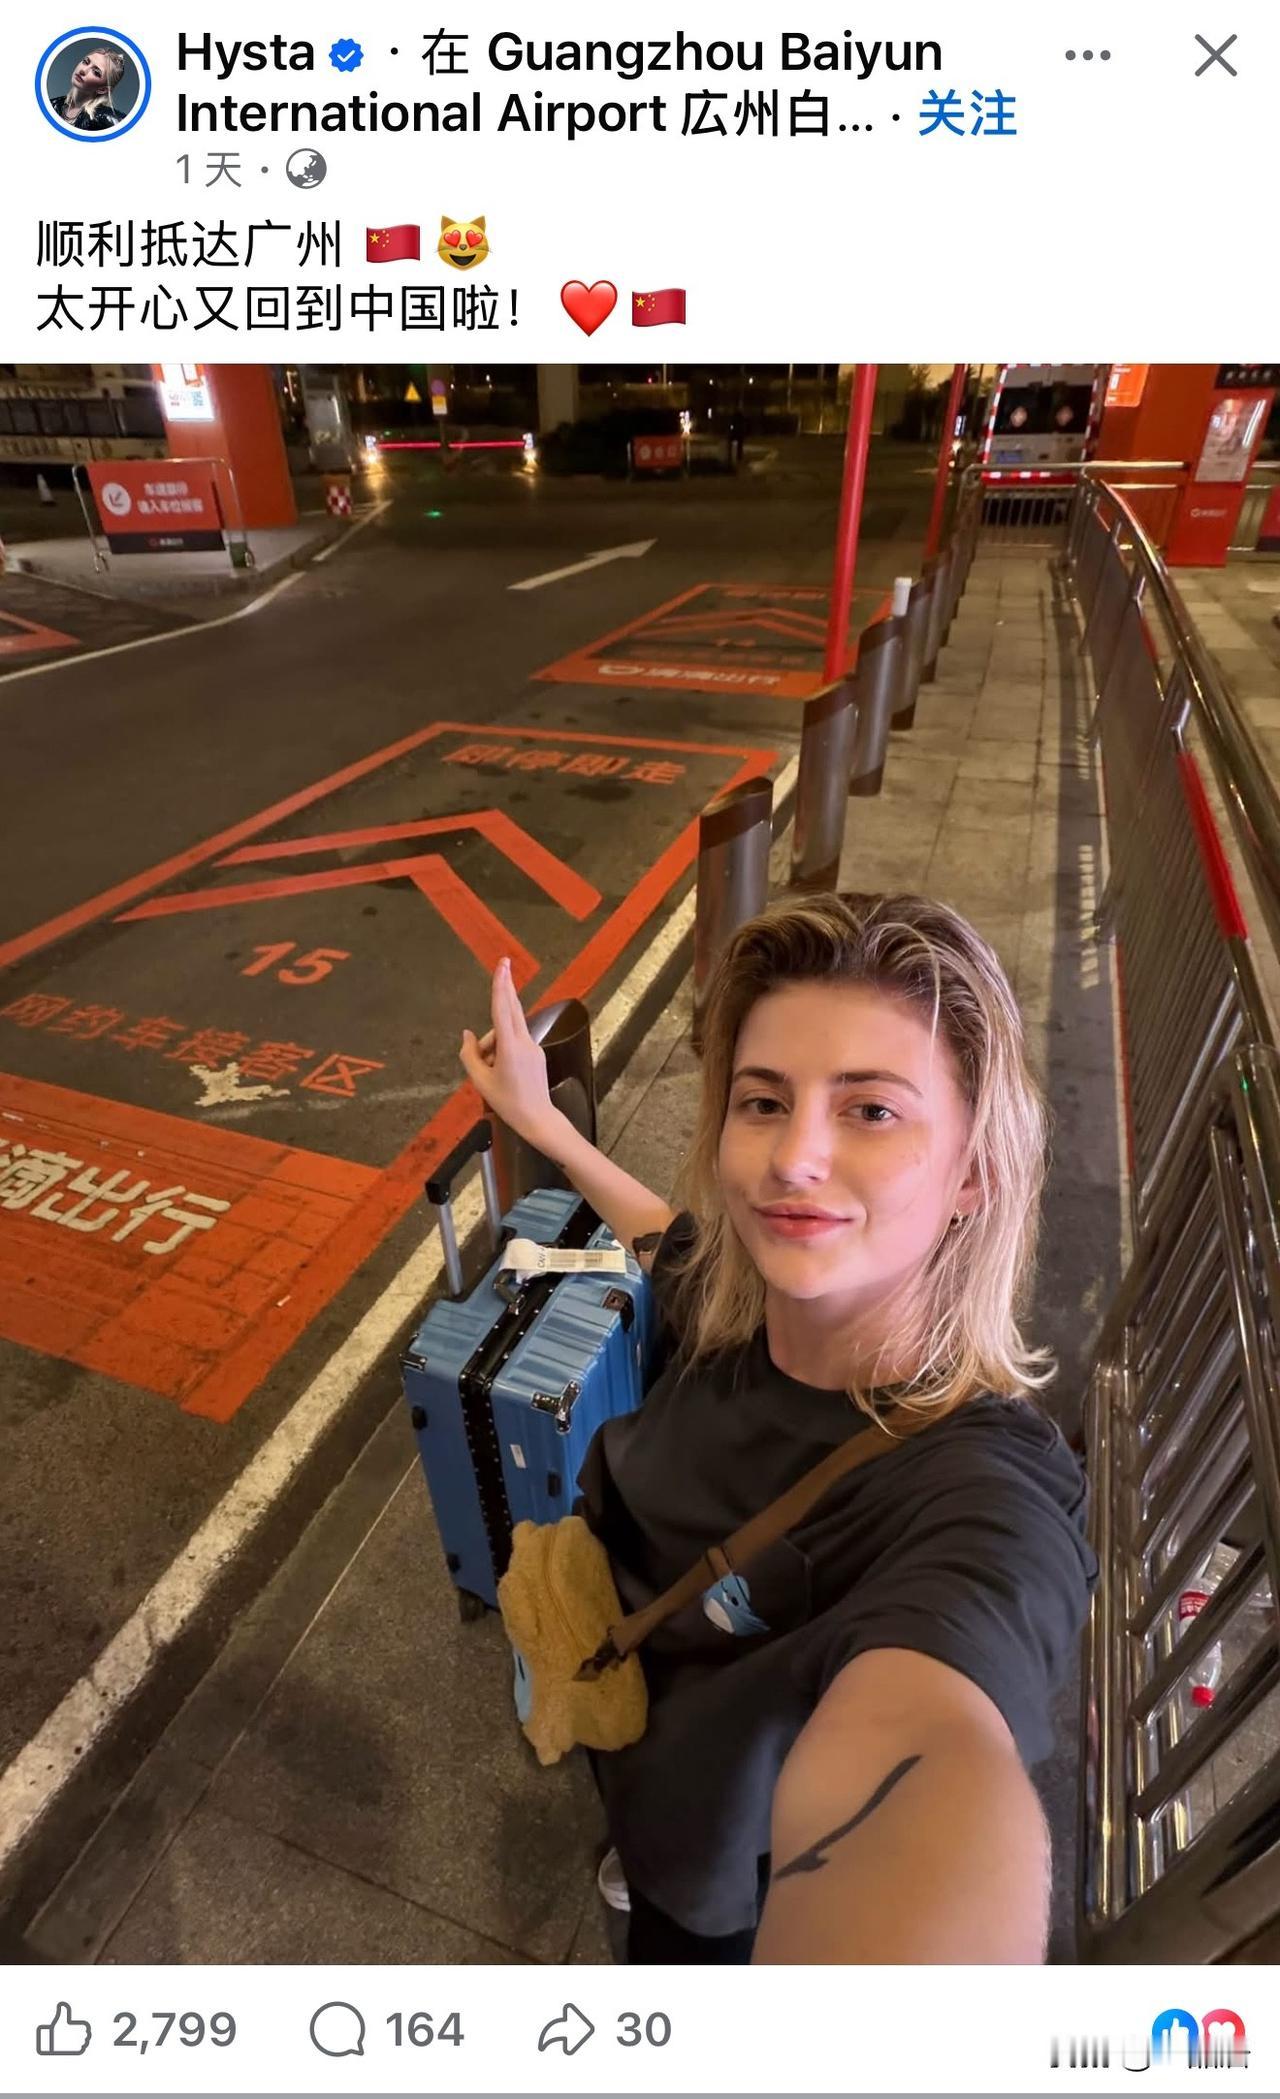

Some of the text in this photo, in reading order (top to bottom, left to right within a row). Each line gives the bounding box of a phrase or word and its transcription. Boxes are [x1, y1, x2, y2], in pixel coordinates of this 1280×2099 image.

[441, 744, 688, 785] 即停即走
[241, 941, 352, 985] 15
[0, 993, 386, 1097] 网约车接客区
[0, 1139, 232, 1256] 滴出行
